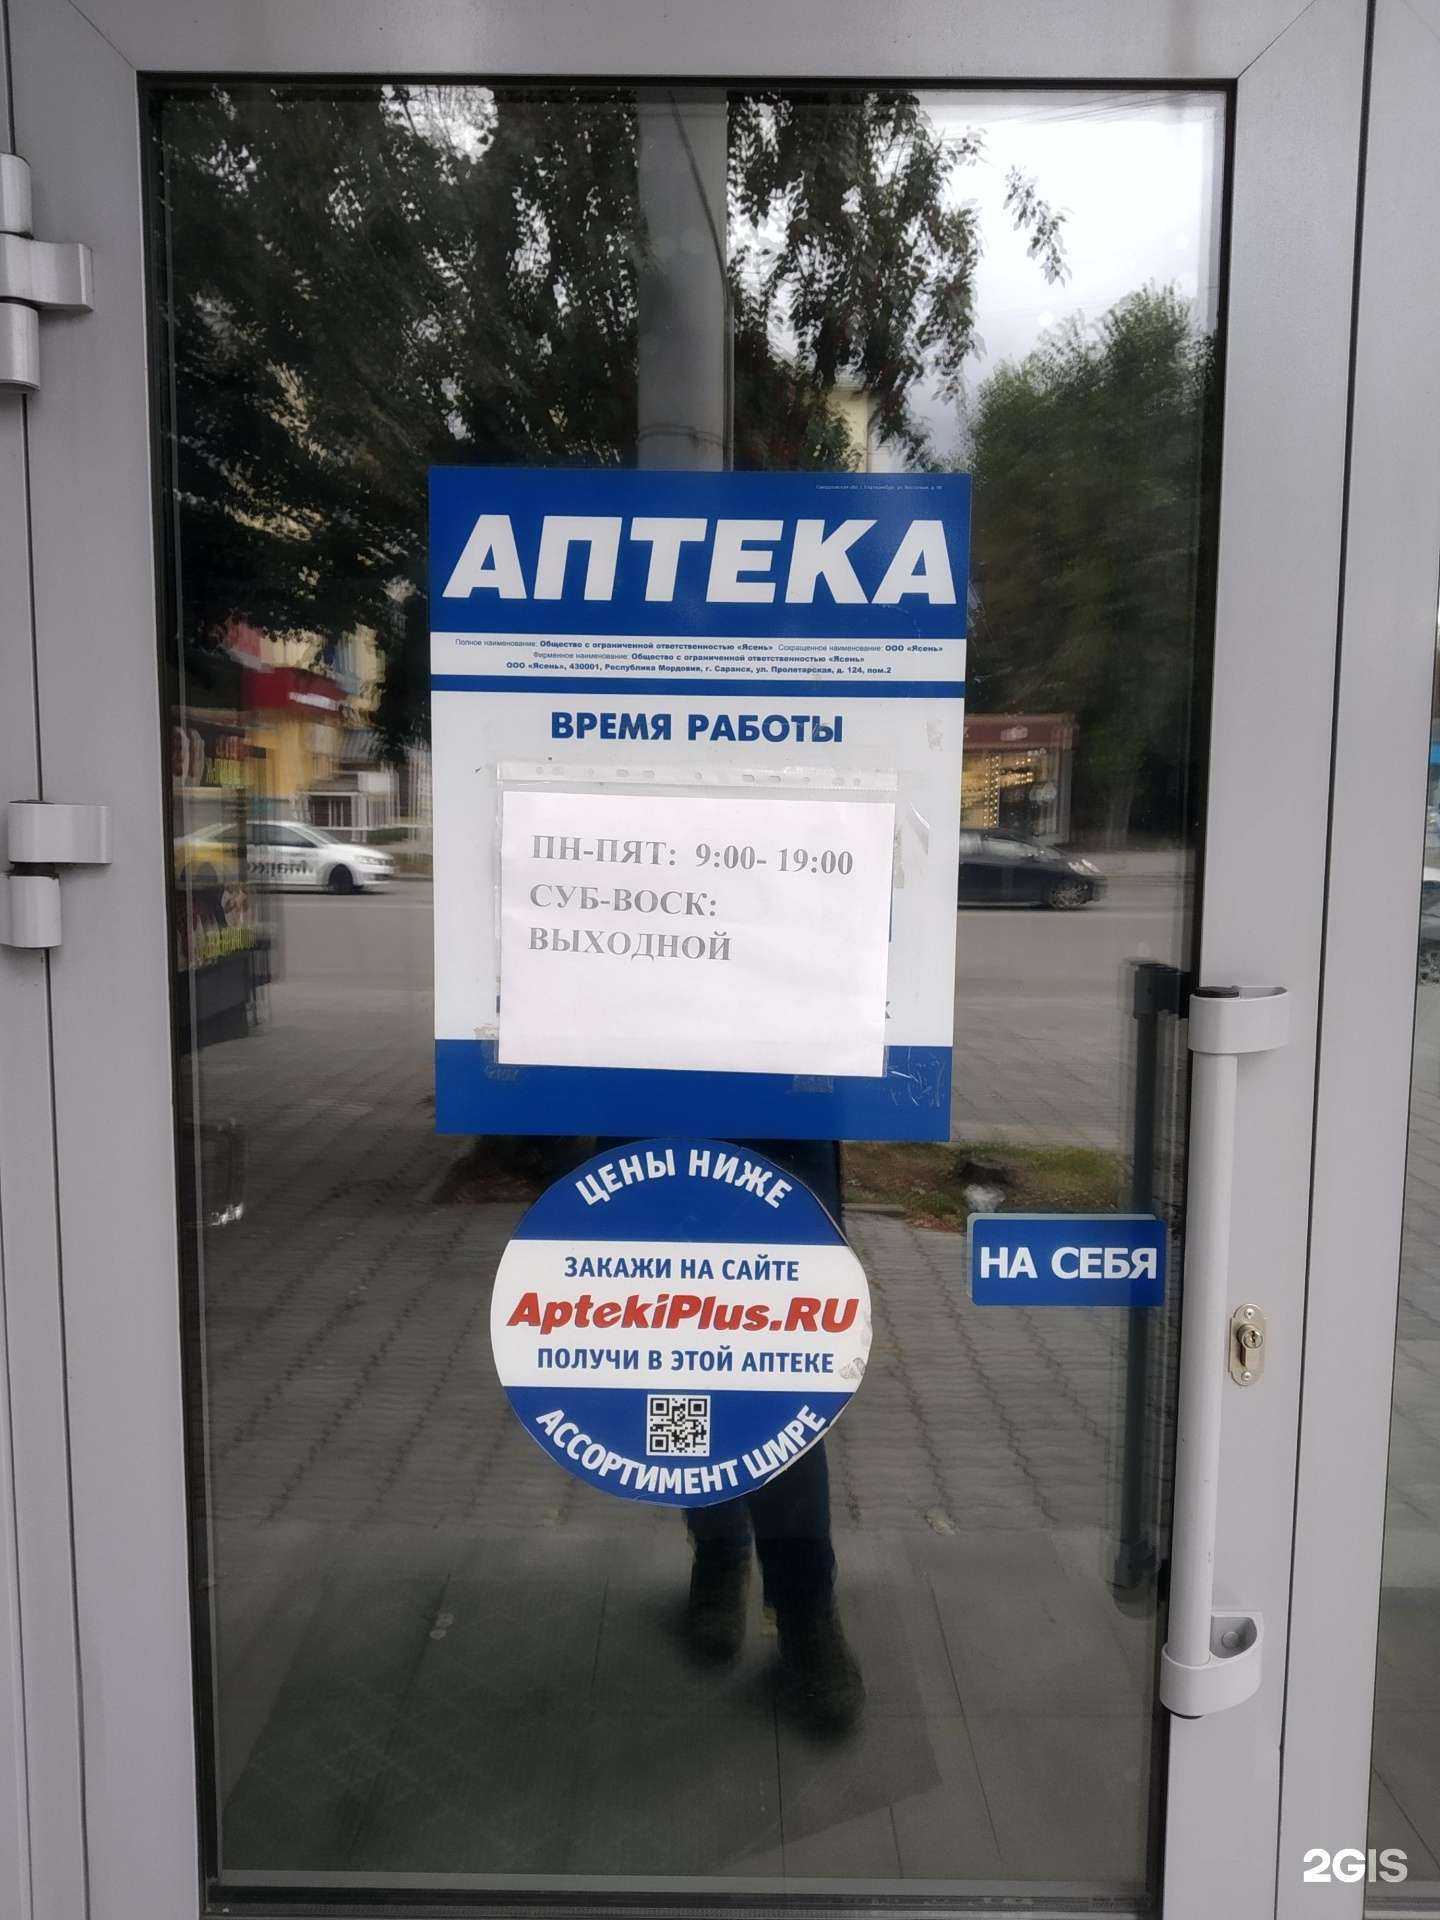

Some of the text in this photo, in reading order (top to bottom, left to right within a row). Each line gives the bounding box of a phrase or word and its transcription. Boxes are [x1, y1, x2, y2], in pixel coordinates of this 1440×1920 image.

[442, 514, 957, 605] АПТЕКА
[455, 638, 482, 647] Полное
[539, 640, 582, 649] Общество
[592, 640, 653, 650] ограниченной
[656, 643, 735, 651] ответственностью
[737, 643, 773, 651] «Ясень»
[631, 653, 674, 661] Общество
[684, 653, 745, 662] ограниченной
[747, 655, 826, 663] ответственностью
[528, 662, 567, 671] «Ясень»,
[569, 663, 602, 672] 430001,
[605, 664, 655, 673] Республика
[658, 665, 703, 673] Мордовия,
[714, 665, 753, 674] Саранск,
[771, 666, 834, 675] Пролетарская,
[847, 667, 864, 675] 124,
[551, 711, 843, 744] ВРЕМЯ РАБОТЫ
[532, 834, 853, 876] ПН-ПЯТ: 9:00- 19:00
[529, 883, 717, 918] СУБ-ВОСК:
[528, 926, 731, 962] ВЫХОДНОЙ
[575, 1148, 792, 1209] ЦЕНЫ НИЖЕ
[564, 1254, 799, 1282] ЗАКАЖИ НА САЙТЕ
[980, 1246, 1157, 1280] НА СЕБЯ
[506, 1291, 859, 1335] AptekiPlus.RU
[537, 1345, 834, 1374] ПОЛУЧИ В ЭТОЙ АПТЕКЕ
[535, 1405, 827, 1495] АССОРТИМЕНТ ШИРЕ
